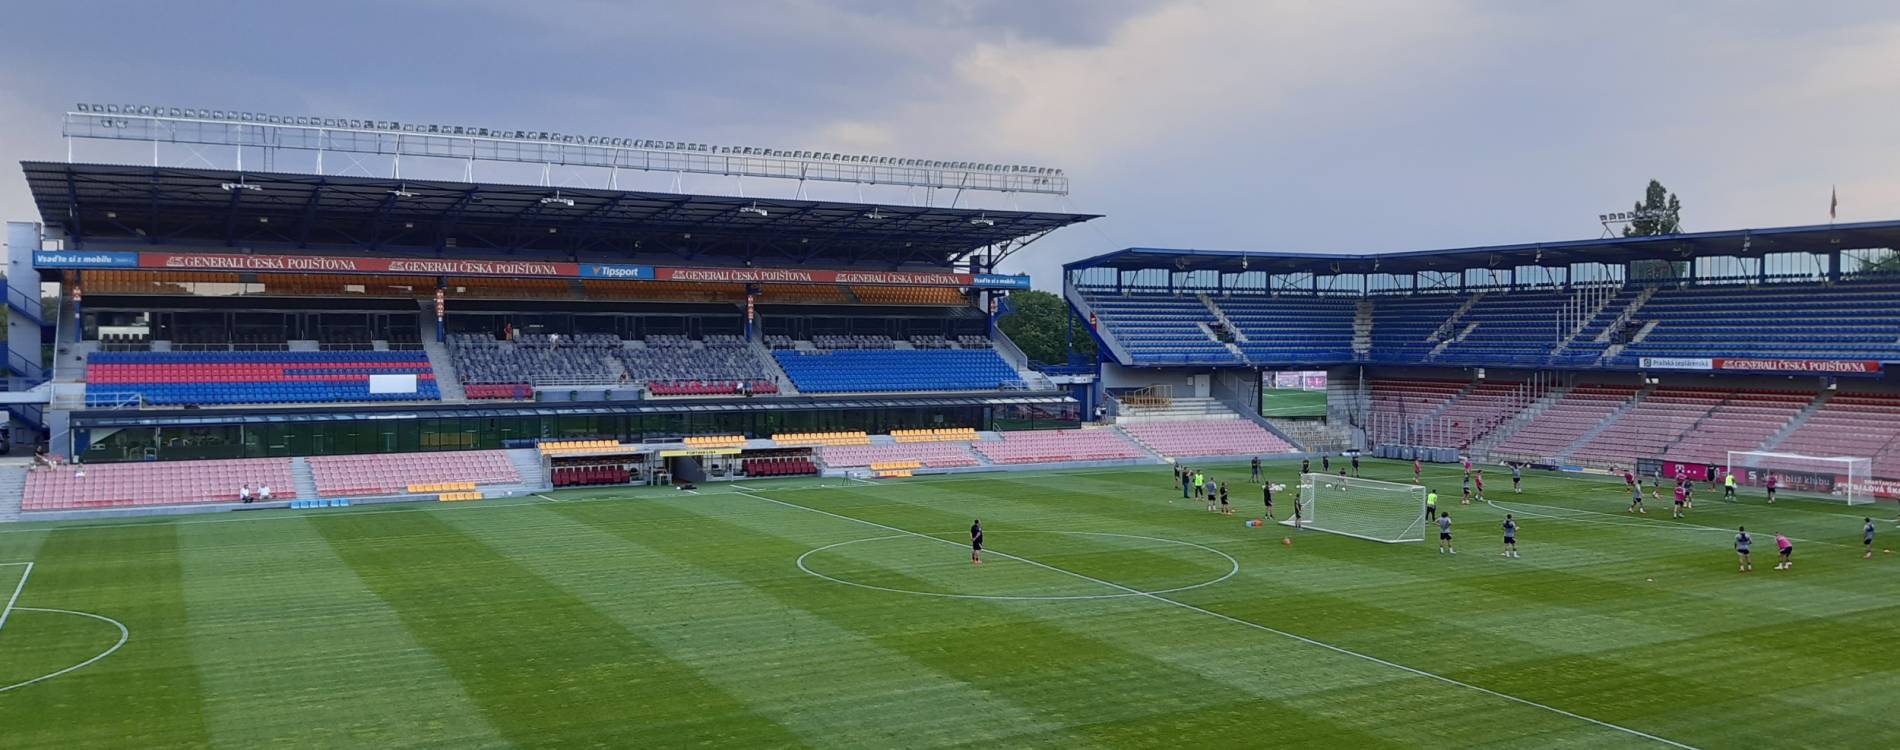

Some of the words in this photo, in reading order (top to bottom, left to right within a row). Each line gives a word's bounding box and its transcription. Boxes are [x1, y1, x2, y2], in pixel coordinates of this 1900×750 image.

[83, 255, 112, 263] mobilu
[185, 257, 243, 268] GENERALI
[247, 256, 284, 268] ČESKÁ
[288, 257, 357, 270] POJIŠŤOVNA
[405, 261, 457, 272] GENERALI
[460, 260, 493, 273] ČESKÁ
[496, 261, 557, 275] POJIŠŤOVNA
[602, 266, 638, 277] Tipsport
[685, 270, 730, 280] GENERALI
[732, 269, 759, 280] ČESKÁ
[761, 269, 812, 281] POJIŠŤOVNA
[847, 273, 885, 283] GENERALI
[888, 272, 912, 283] ČESKÁ
[914, 273, 959, 284] POJIŠŤOVNA
[1734, 361, 1776, 370] GENERALI
[1778, 360, 1807, 371] ČESKÁ
[1810, 361, 1865, 372] POJIŠŤOVNA
